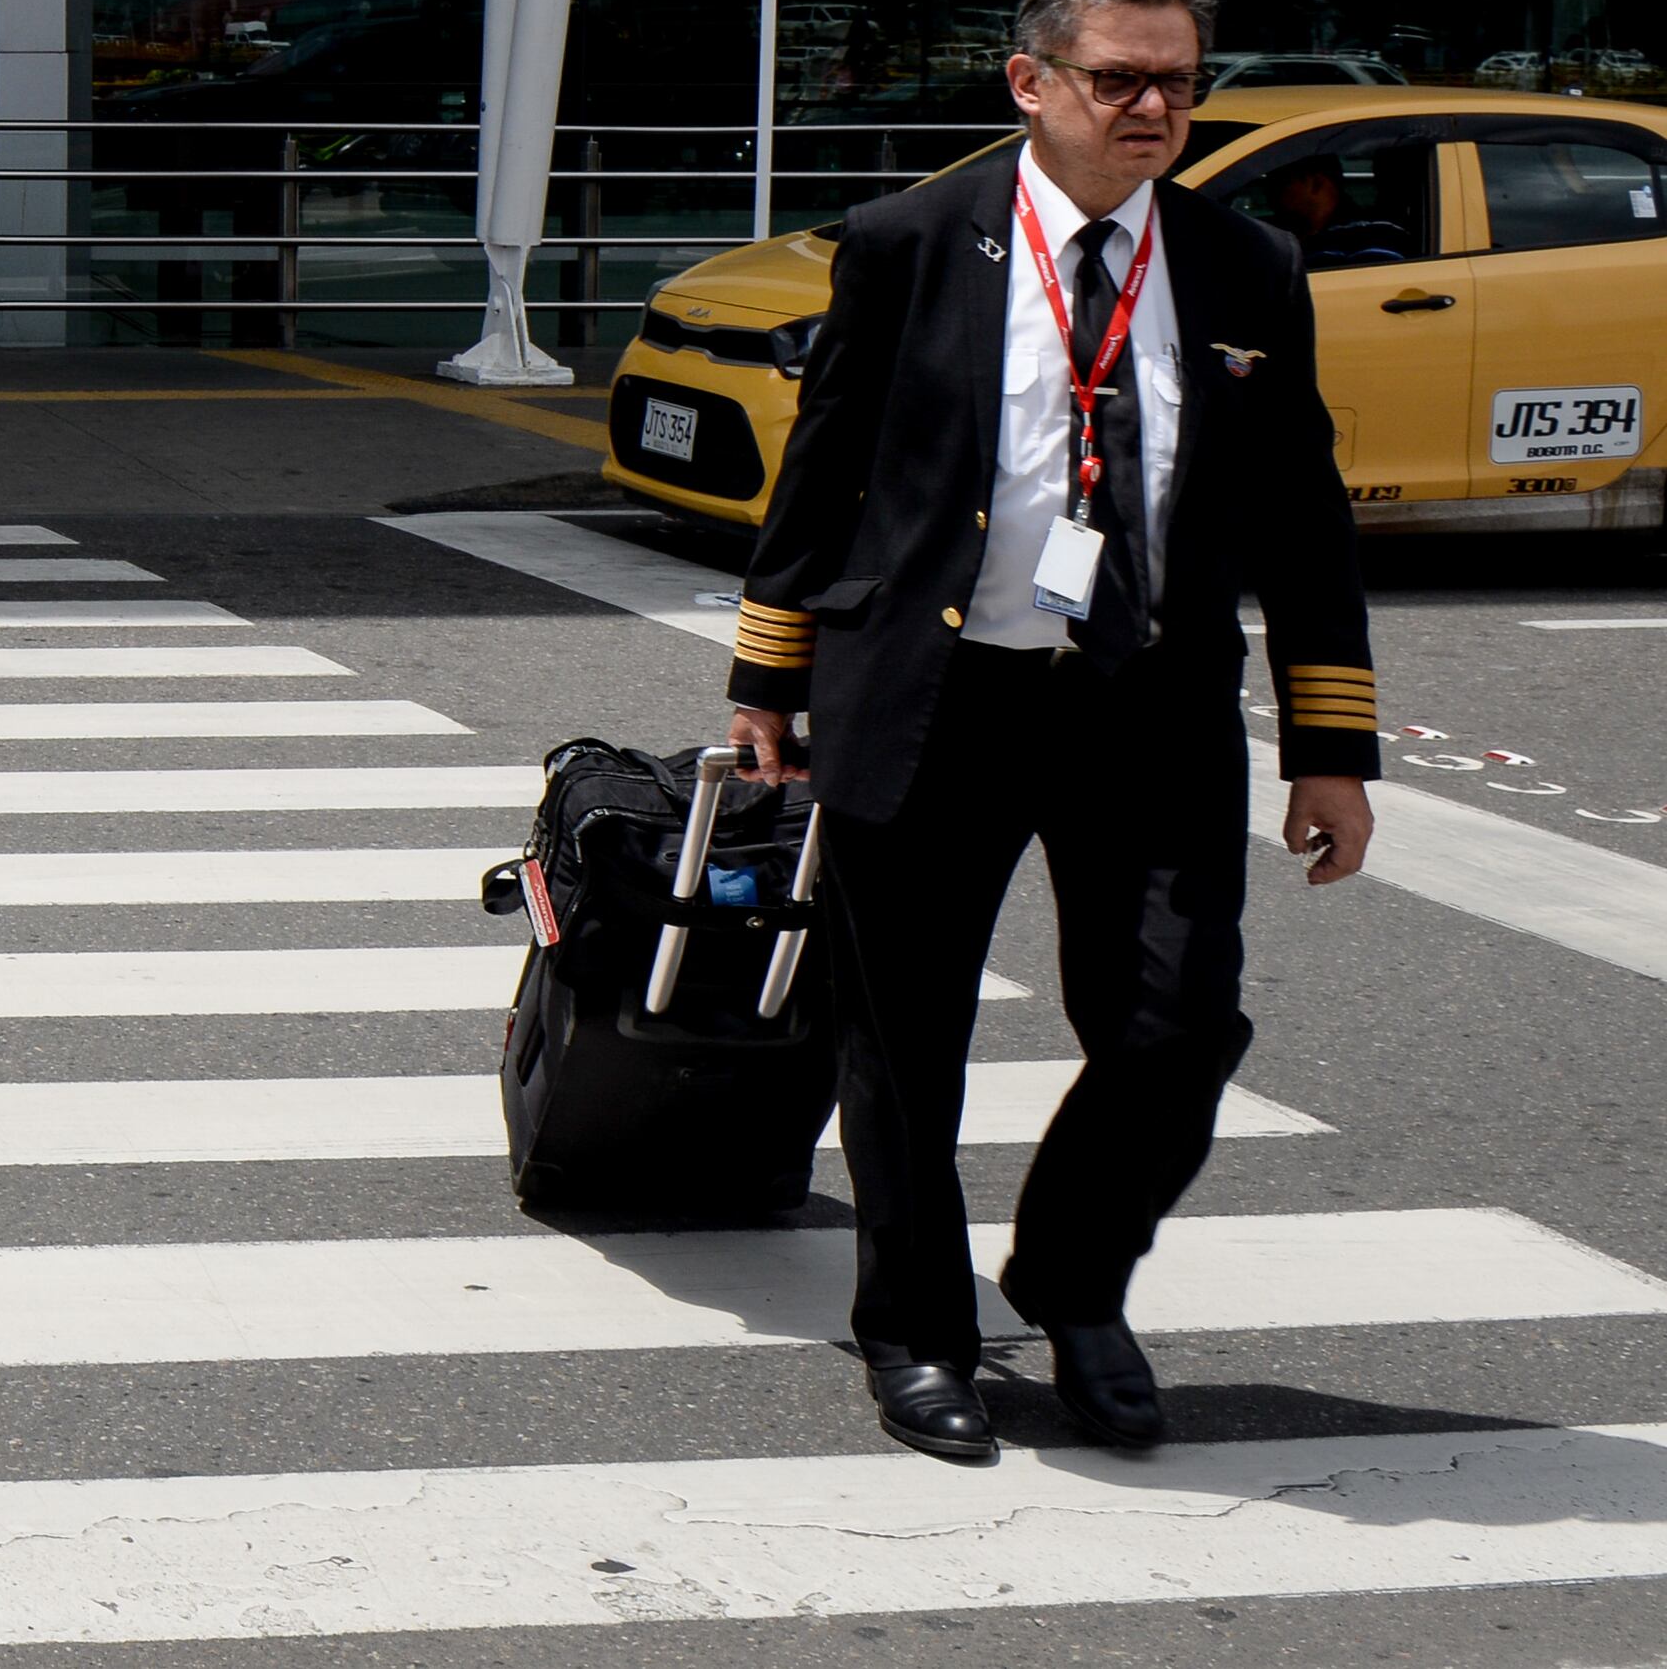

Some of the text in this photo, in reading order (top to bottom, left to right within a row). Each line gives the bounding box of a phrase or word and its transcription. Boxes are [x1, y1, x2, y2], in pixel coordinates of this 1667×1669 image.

[1127, 269, 1143, 297] Avianca
[1099, 341, 1116, 369] Avianca
[645, 405, 692, 445] JTS 354
[1495, 399, 1637, 438] JTS 354
[1527, 445, 1577, 458] BOGOTA
[534, 883, 553, 934] Avianca
